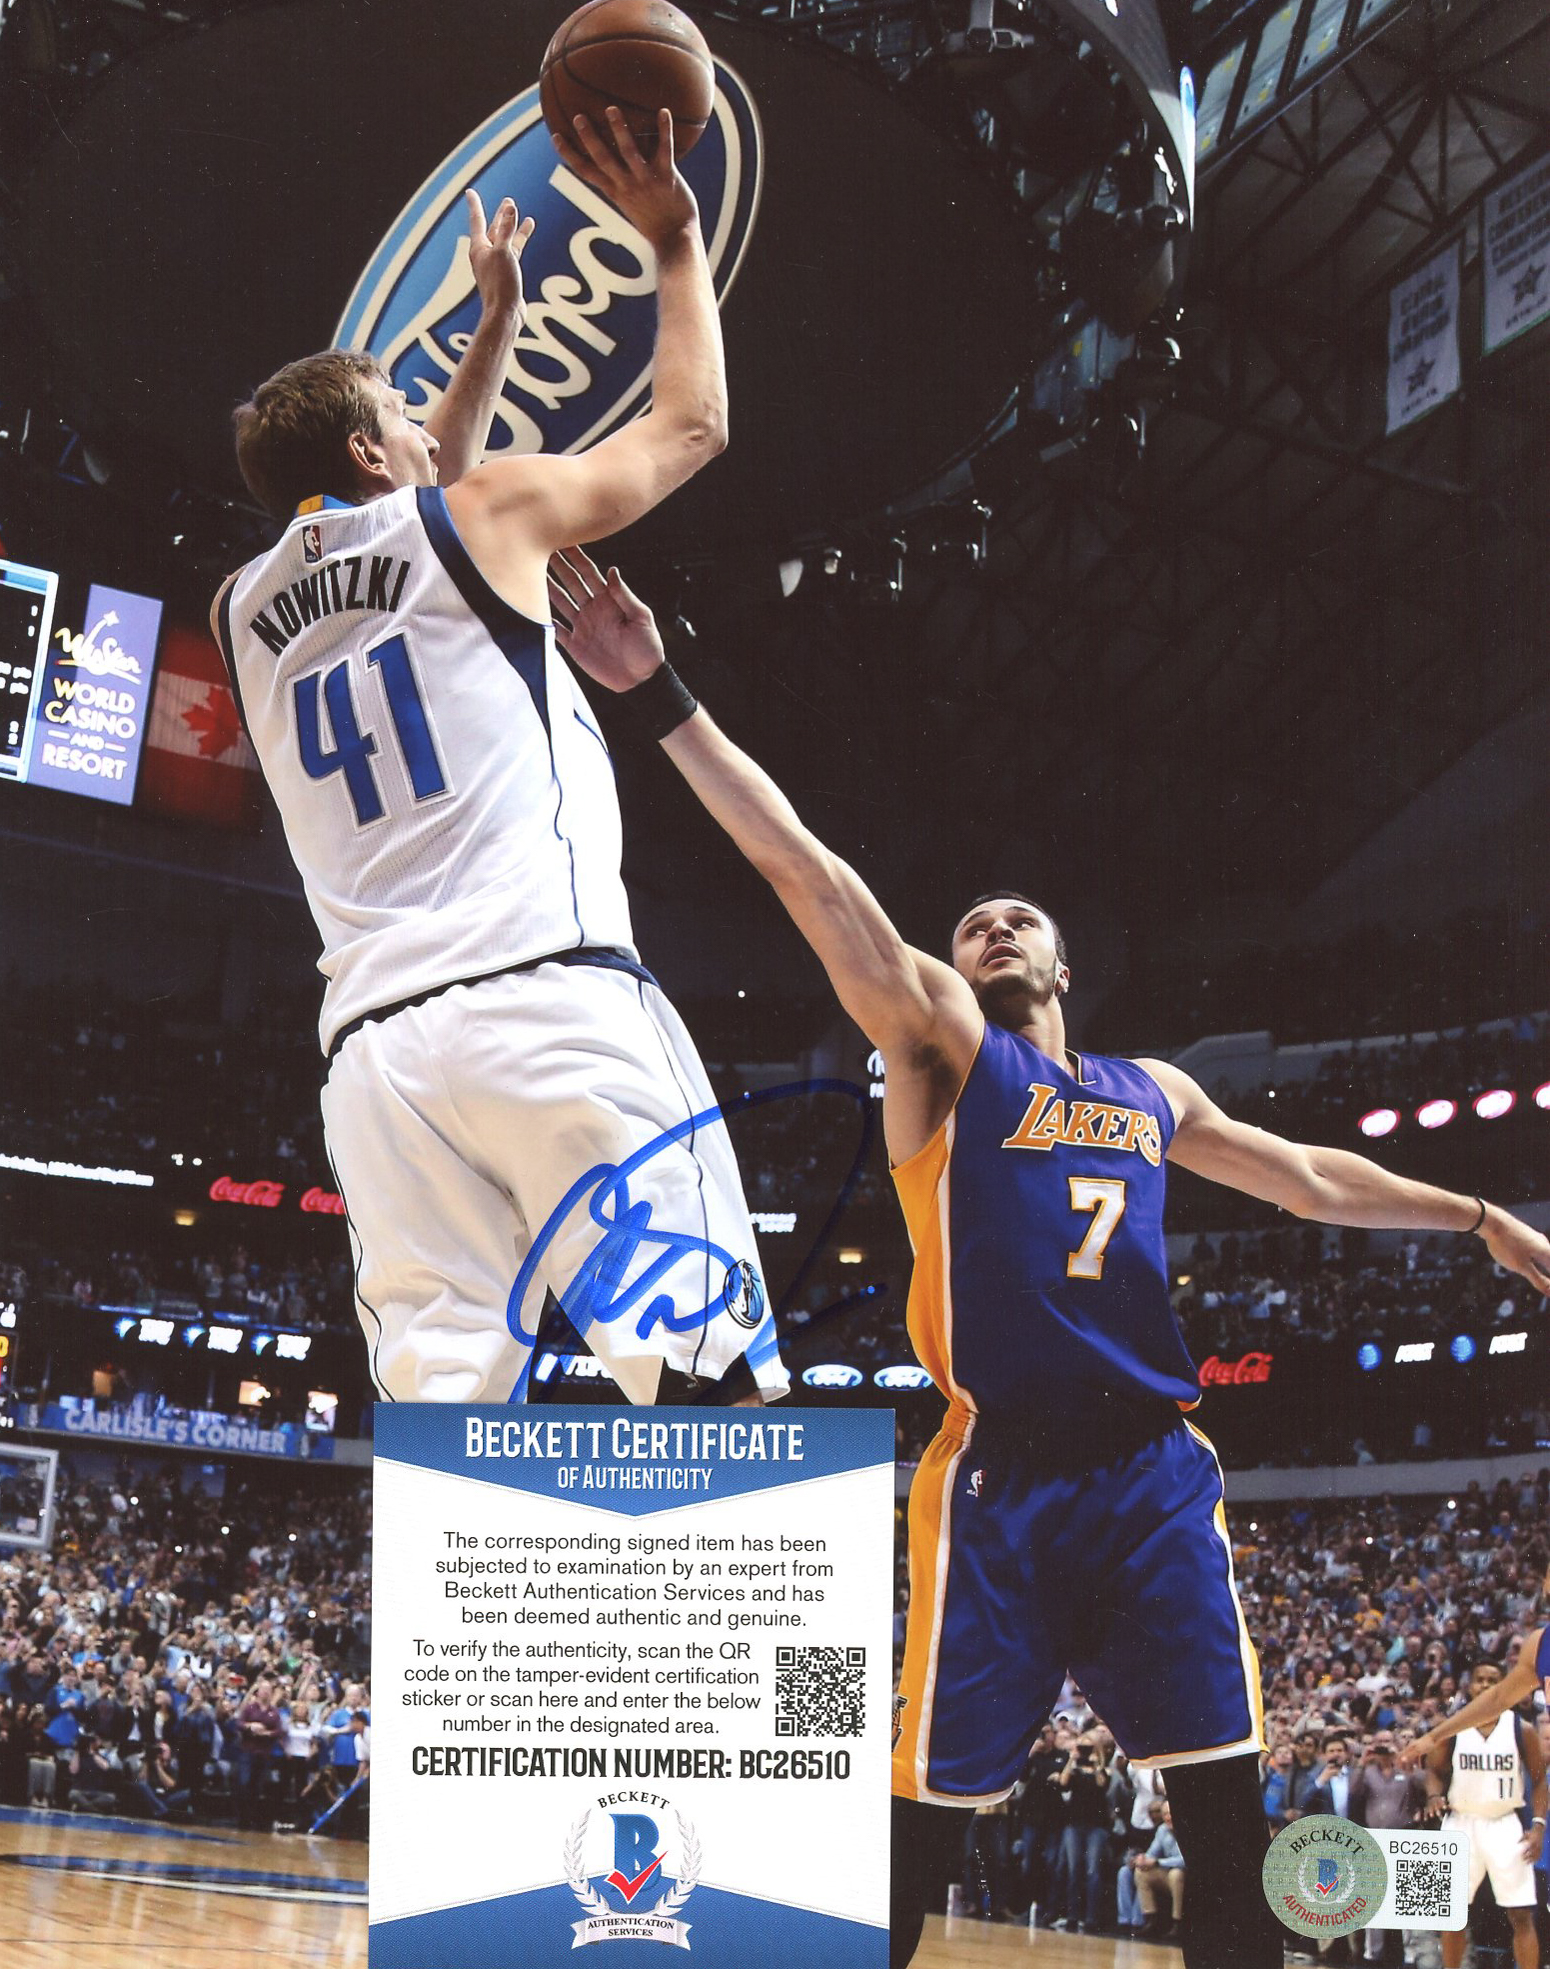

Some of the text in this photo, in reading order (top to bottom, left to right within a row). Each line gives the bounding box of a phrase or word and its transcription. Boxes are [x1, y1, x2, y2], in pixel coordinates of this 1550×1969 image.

[378, 164, 658, 462] Ford
[250, 556, 411, 656] NOWITZKI
[54, 677, 136, 715] WORLD
[45, 701, 137, 739] CASINO
[288, 628, 455, 833] 41
[70, 732, 105, 750] AND
[42, 743, 128, 780] RESORT
[1001, 1083, 1162, 1167] LAKERS
[1066, 1177, 1126, 1280] 7
[64, 1409, 286, 1454] CARLISLE'S CORNER
[465, 1417, 805, 1461] BECKETT CERTIFICATE
[558, 1465, 713, 1490] OF AUTHENTICITY
[444, 1532, 827, 1554] The corresponding signed item has been
[436, 1557, 834, 1580] subjected to examination by an expert from
[446, 1582, 825, 1602] Beckett Authentication Services and has
[463, 1607, 807, 1631] been deemed authentic and genuine.
[413, 1640, 750, 1663] To verify the authenticity, scan the QR
[405, 1665, 758, 1686] code on the tamper-evident certification
[403, 1690, 760, 1708] sticker or scan here and enter the below
[443, 1715, 718, 1737] number in the designated area.
[412, 1746, 851, 1780] CERTIFICATION NUMBER: BC26510
[1459, 1753, 1515, 1771] DALLAS
[597, 1791, 670, 1809] BECKETT
[1498, 1777, 1514, 1799] 11
[1289, 1829, 1365, 1855] BECKETT
[1389, 1841, 1458, 1856] BC26510
[1282, 1895, 1367, 1926] AUTHENTICATED
[587, 1917, 675, 1930] AUTHENTICATION
[608, 1928, 653, 1937] SERVICES
